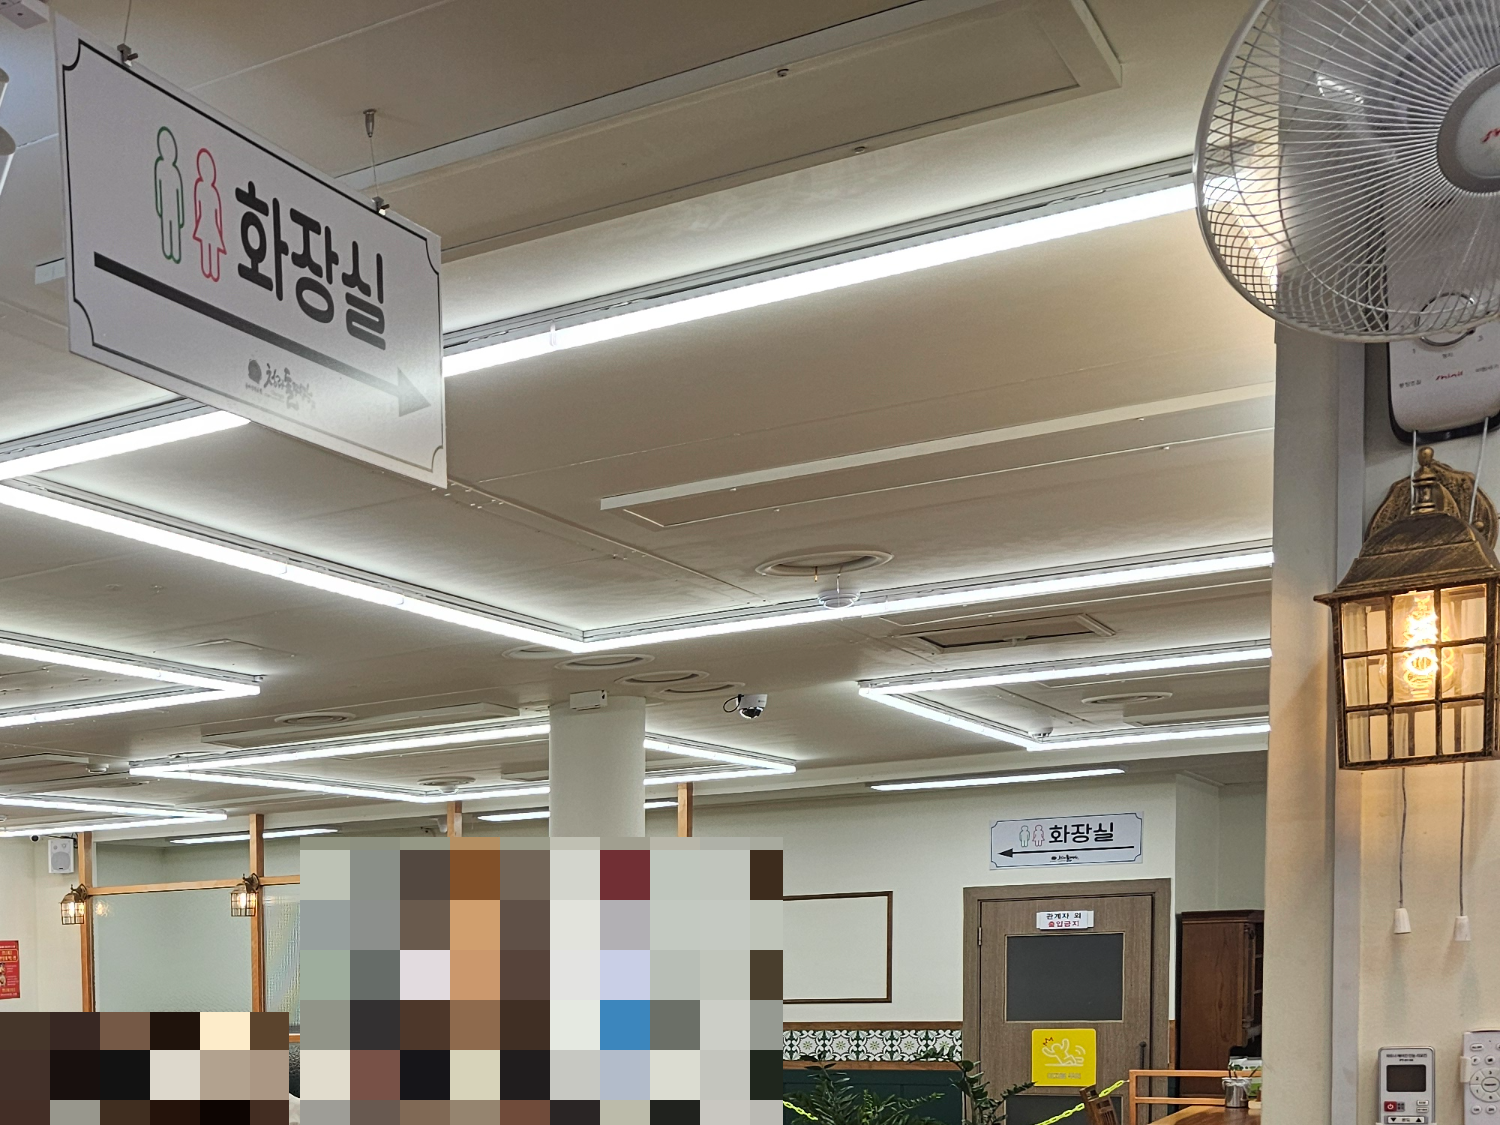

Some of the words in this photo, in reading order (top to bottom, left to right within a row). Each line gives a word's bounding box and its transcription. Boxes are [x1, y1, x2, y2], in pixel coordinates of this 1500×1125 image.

[235, 181, 386, 351] 화장실
[1048, 822, 1114, 844] 화장실
[1046, 912, 1069, 920] 관계자
[1048, 920, 1080, 928] 출입금지
